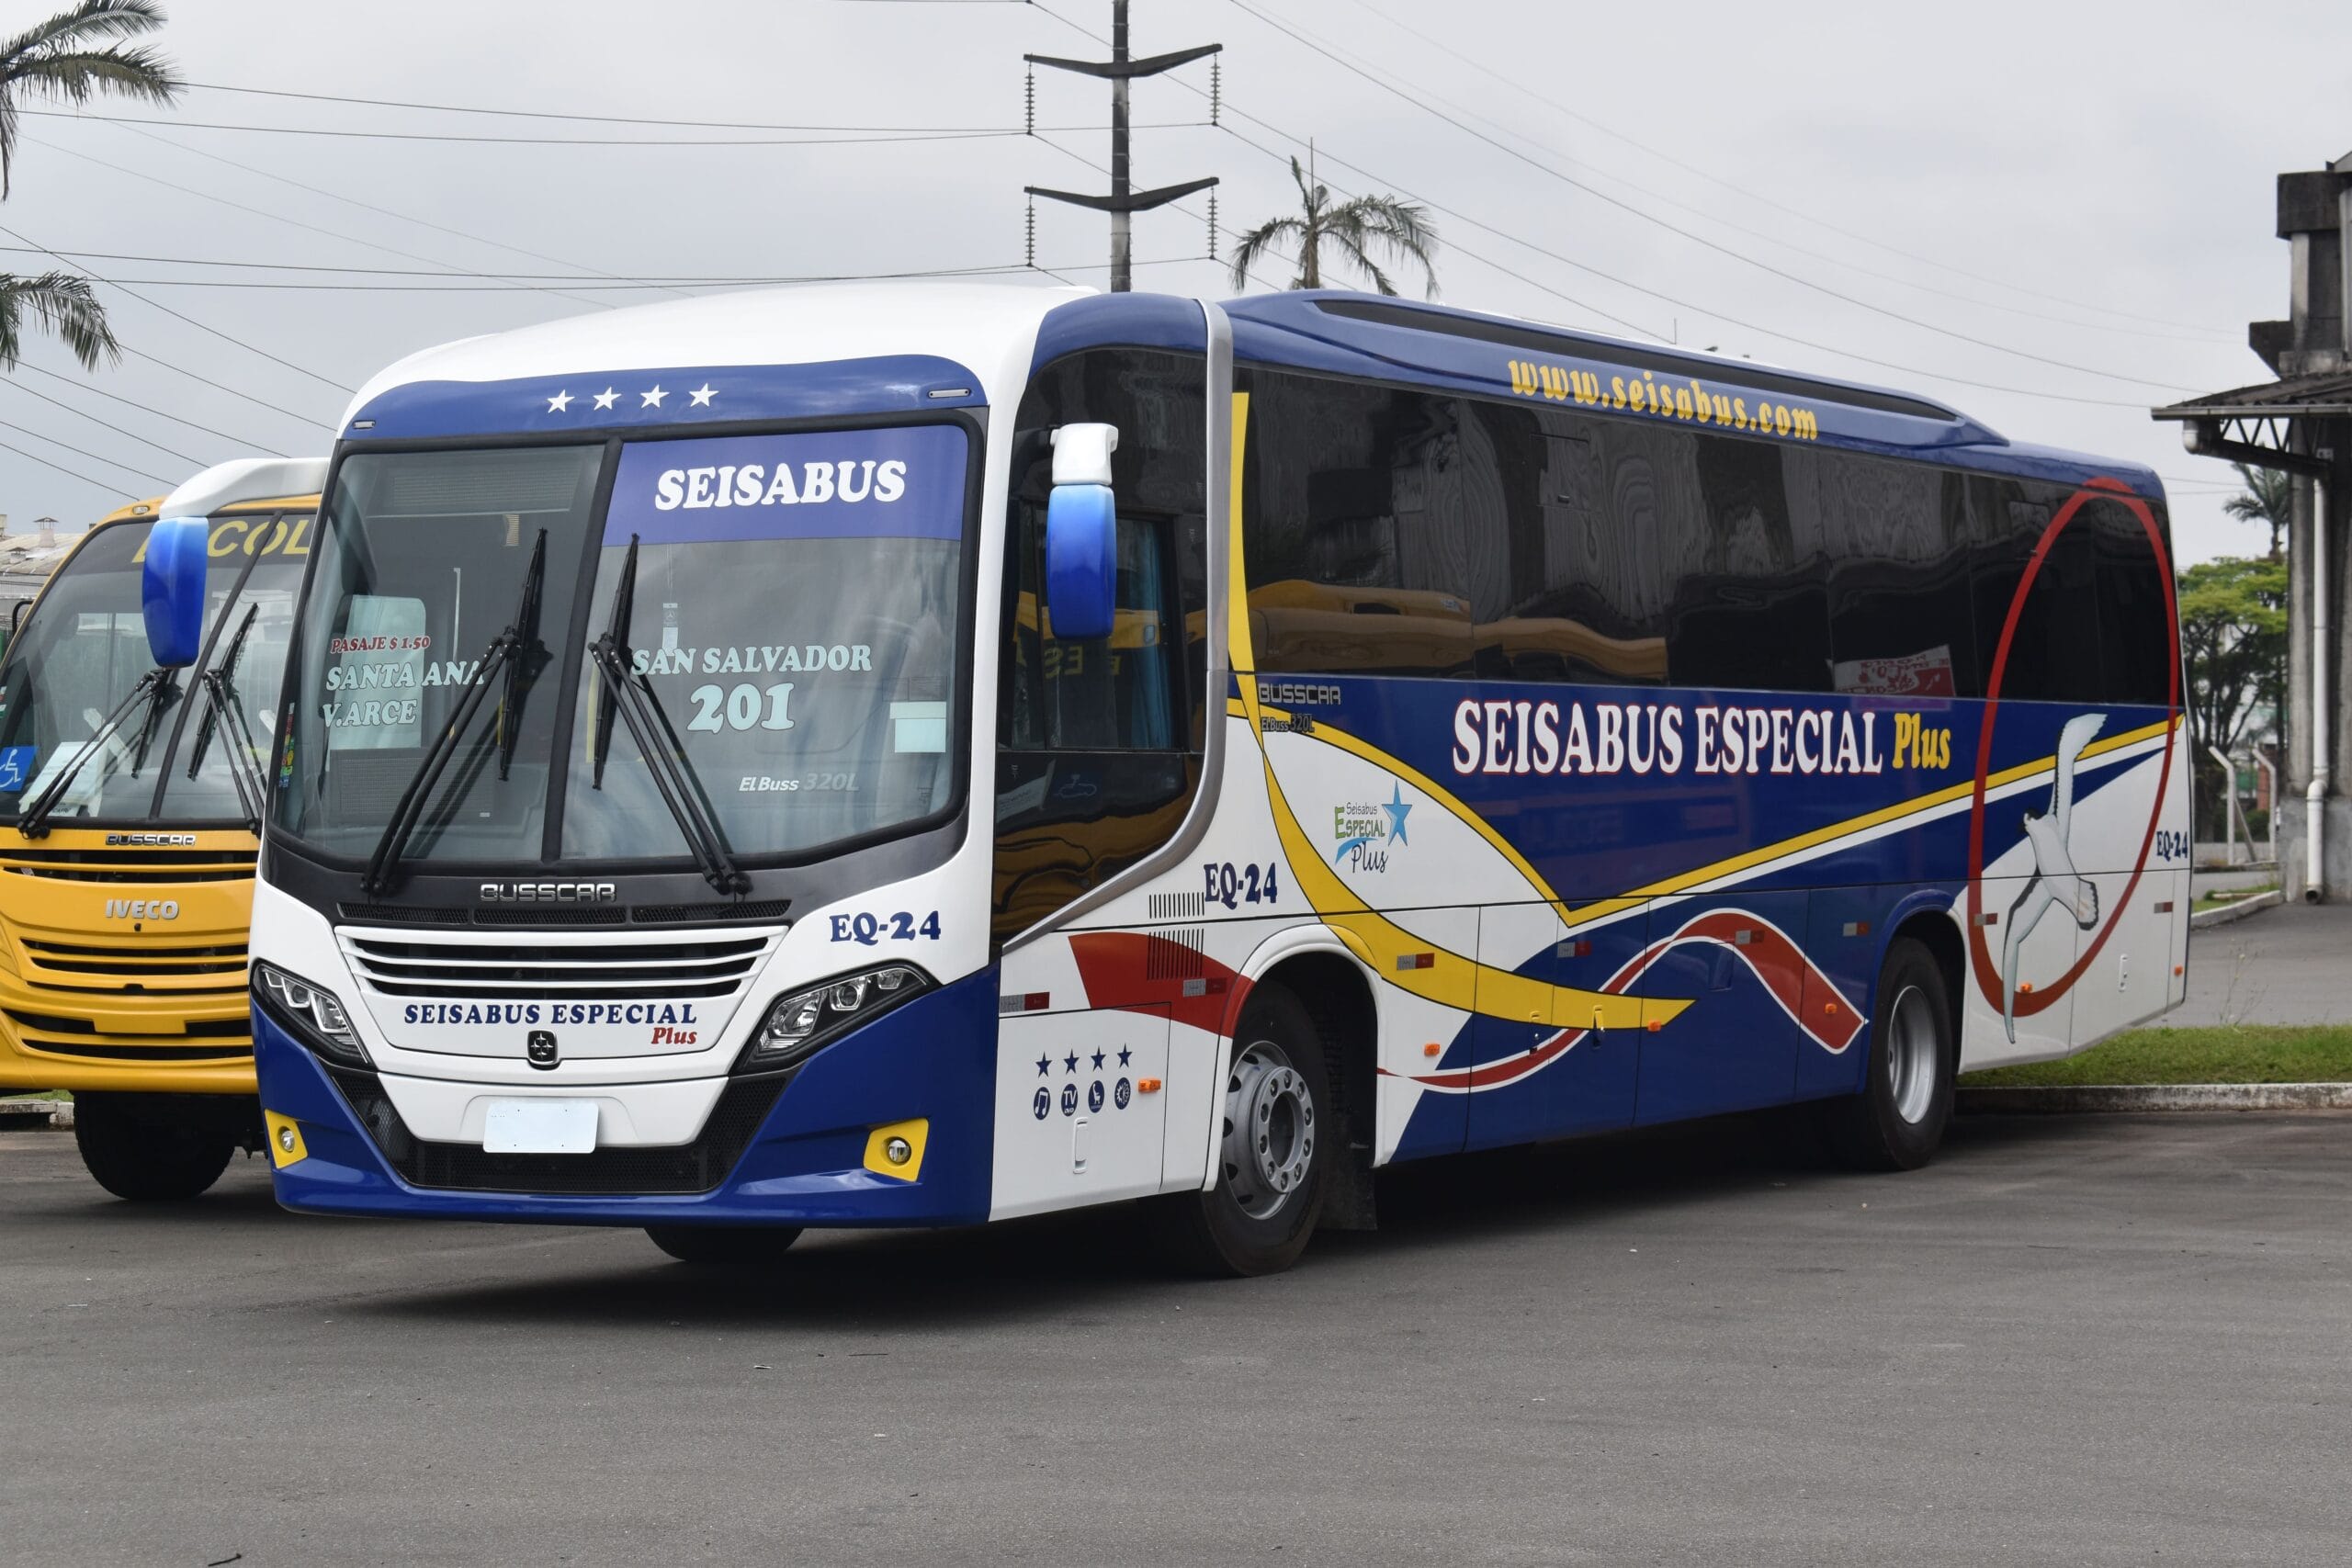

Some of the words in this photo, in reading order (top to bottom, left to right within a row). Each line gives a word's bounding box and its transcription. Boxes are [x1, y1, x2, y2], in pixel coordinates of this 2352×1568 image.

[1508, 360, 1818, 441] www.seisabus.com
[655, 460, 907, 511] SEISABUS
[331, 637, 387, 654] PASAJE
[390, 637, 398, 650] $
[401, 636, 431, 650] 1.50
[631, 649, 696, 675] SAN
[702, 645, 872, 674] SALVADOR
[326, 662, 415, 691] SANTA
[686, 682, 795, 734] 201
[1258, 683, 1341, 705] BUSSCAR
[322, 699, 417, 728] V.ARCE
[1453, 699, 1683, 774] SEISABUS
[1694, 706, 1883, 774] ESPECIAL
[1892, 712, 1951, 770] Plus
[803, 773, 860, 792] 320L
[106, 834, 196, 845] BUSSCAR
[2156, 830, 2188, 862] EQ-24
[1351, 840, 1389, 874] Plus
[480, 883, 616, 903] BUSSCAR
[1204, 862, 1277, 910] EQ-24
[106, 899, 179, 919] IVECO
[829, 910, 942, 946] EQ-24
[404, 1003, 541, 1024] SEISABUS
[550, 1003, 698, 1024] ESPECIAL
[650, 1026, 697, 1045] Plus
[1064, 1090, 1078, 1106] TV
